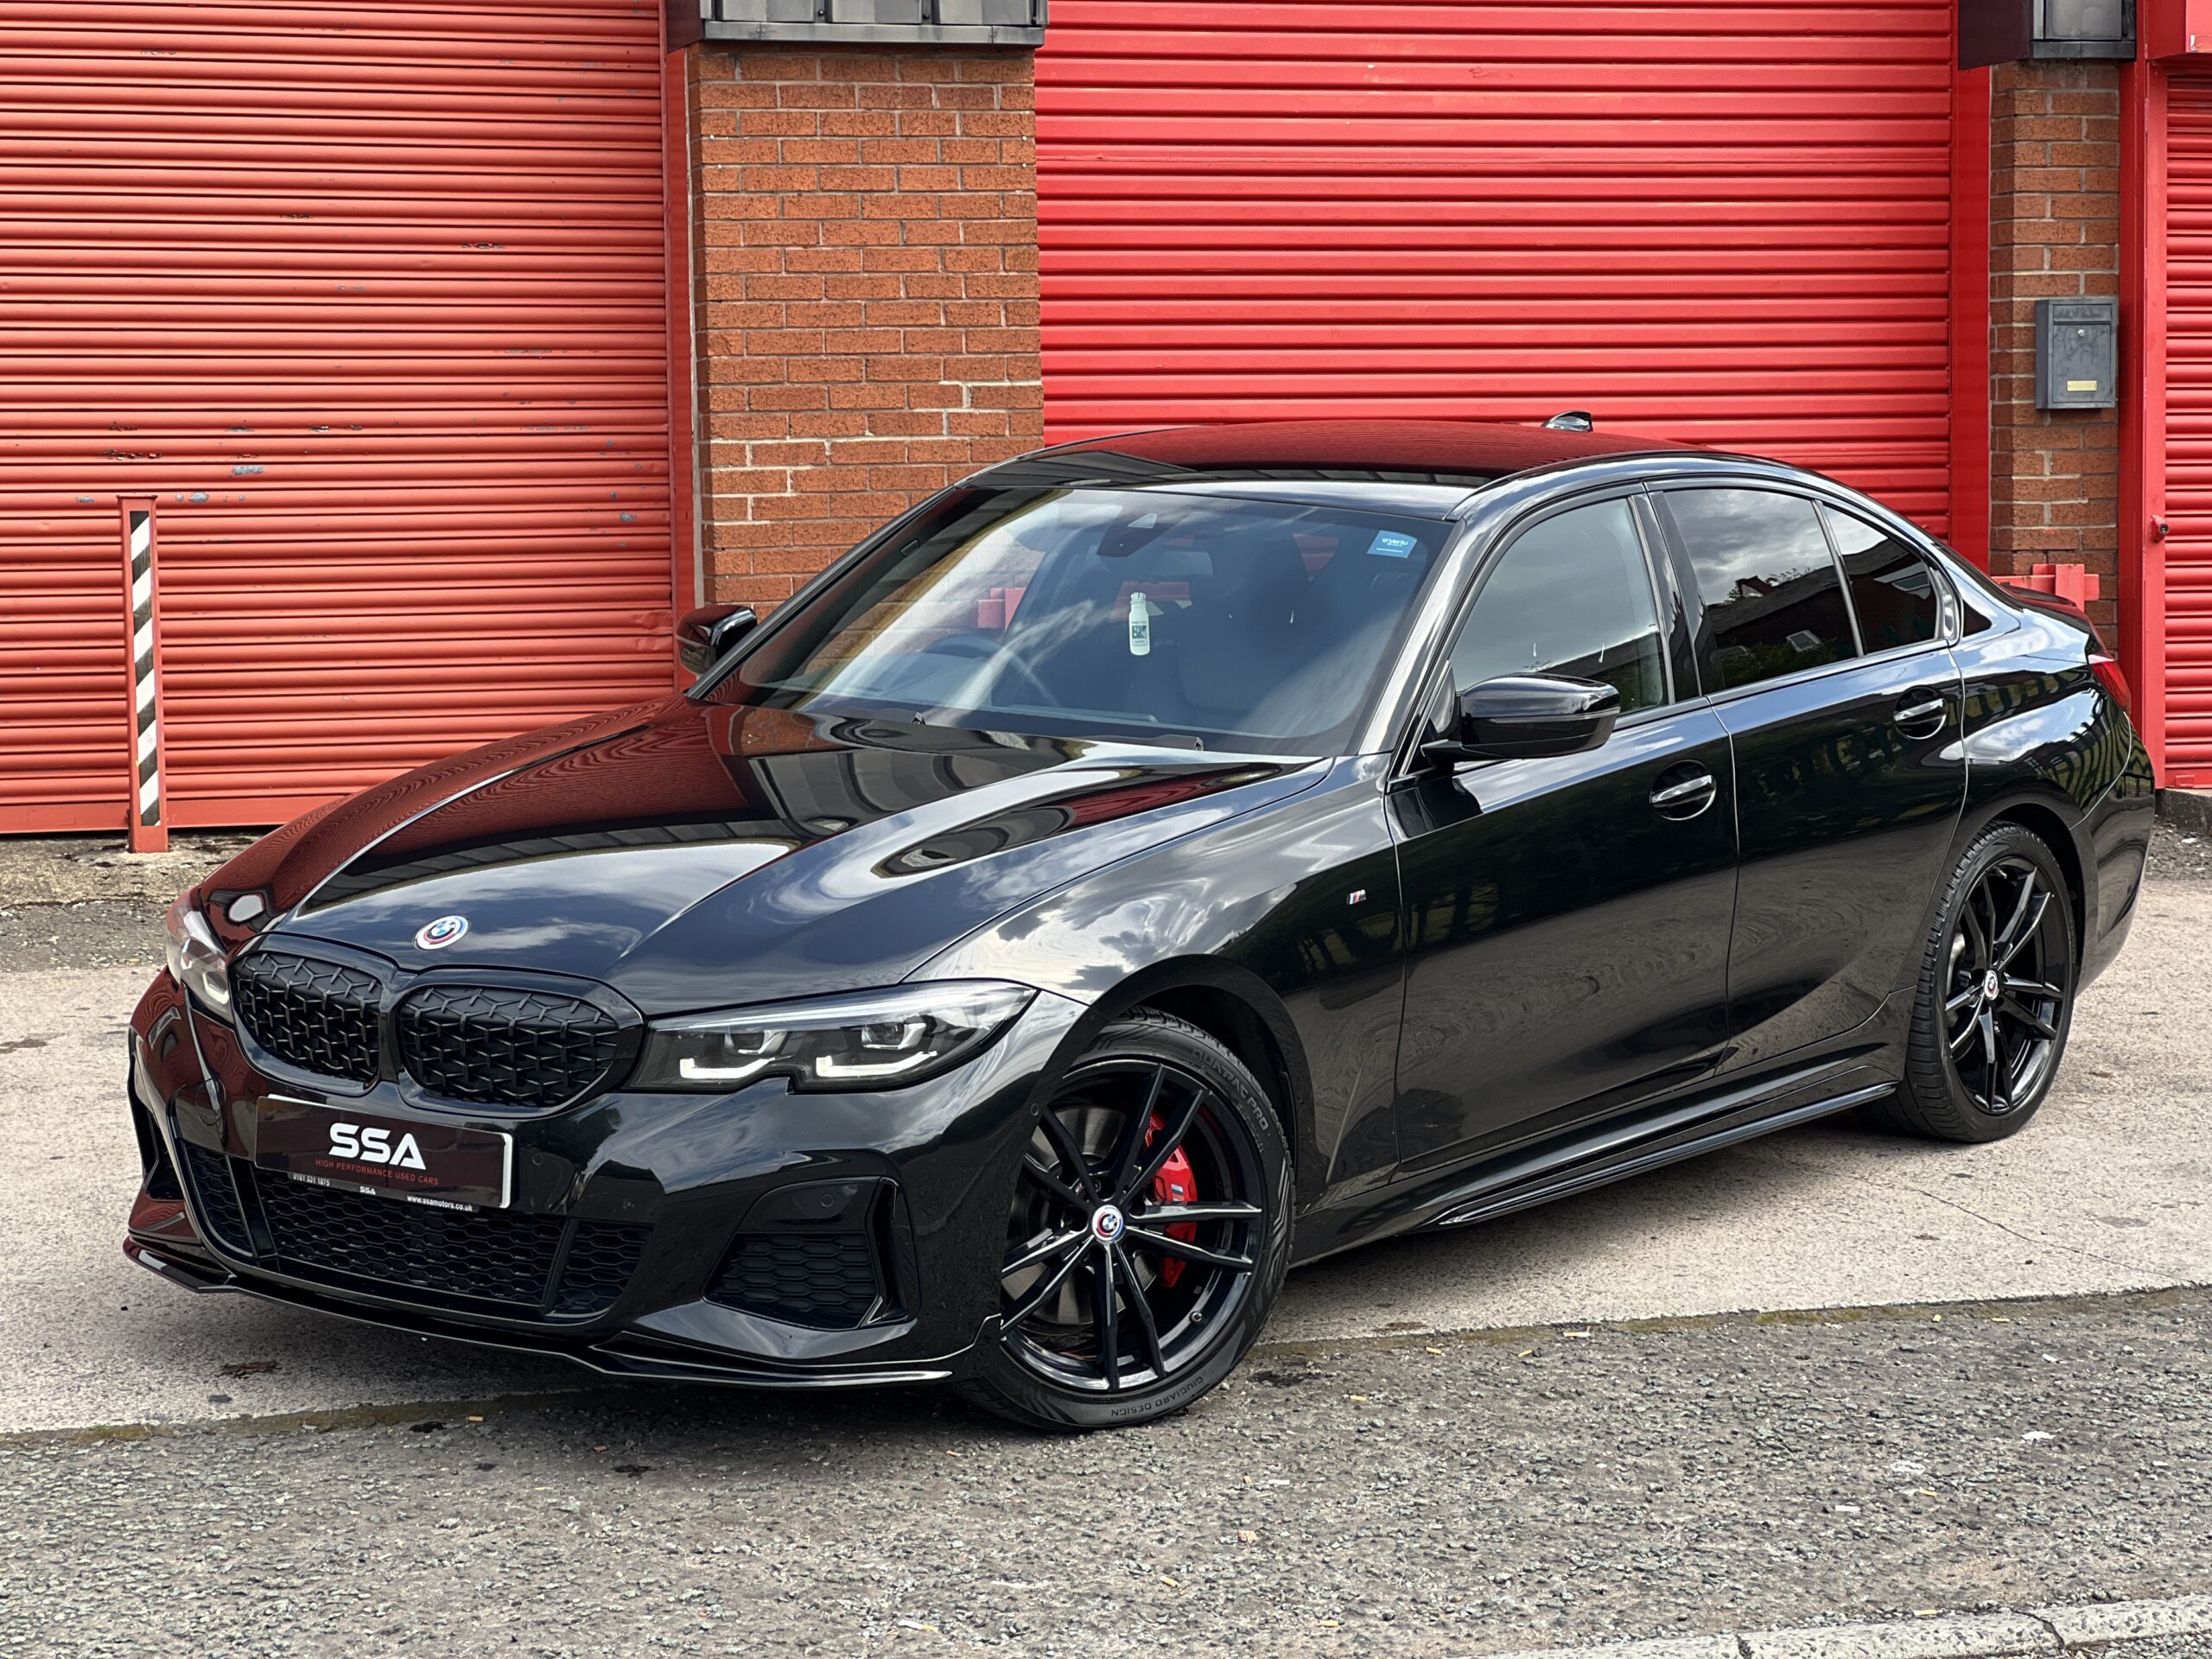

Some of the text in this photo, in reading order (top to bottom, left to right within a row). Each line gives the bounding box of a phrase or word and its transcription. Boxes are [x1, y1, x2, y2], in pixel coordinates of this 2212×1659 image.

[1246, 1096, 1268, 1131] PRO
[329, 1122, 427, 1170] SSA
[315, 1159, 439, 1185] HIGH PERFORMANCE USED CARS
[359, 1185, 377, 1195] SSA
[406, 1195, 474, 1212] www.ssamotors.co.uk
[1110, 1376, 1204, 1416] GIUGIARO DESIGN
